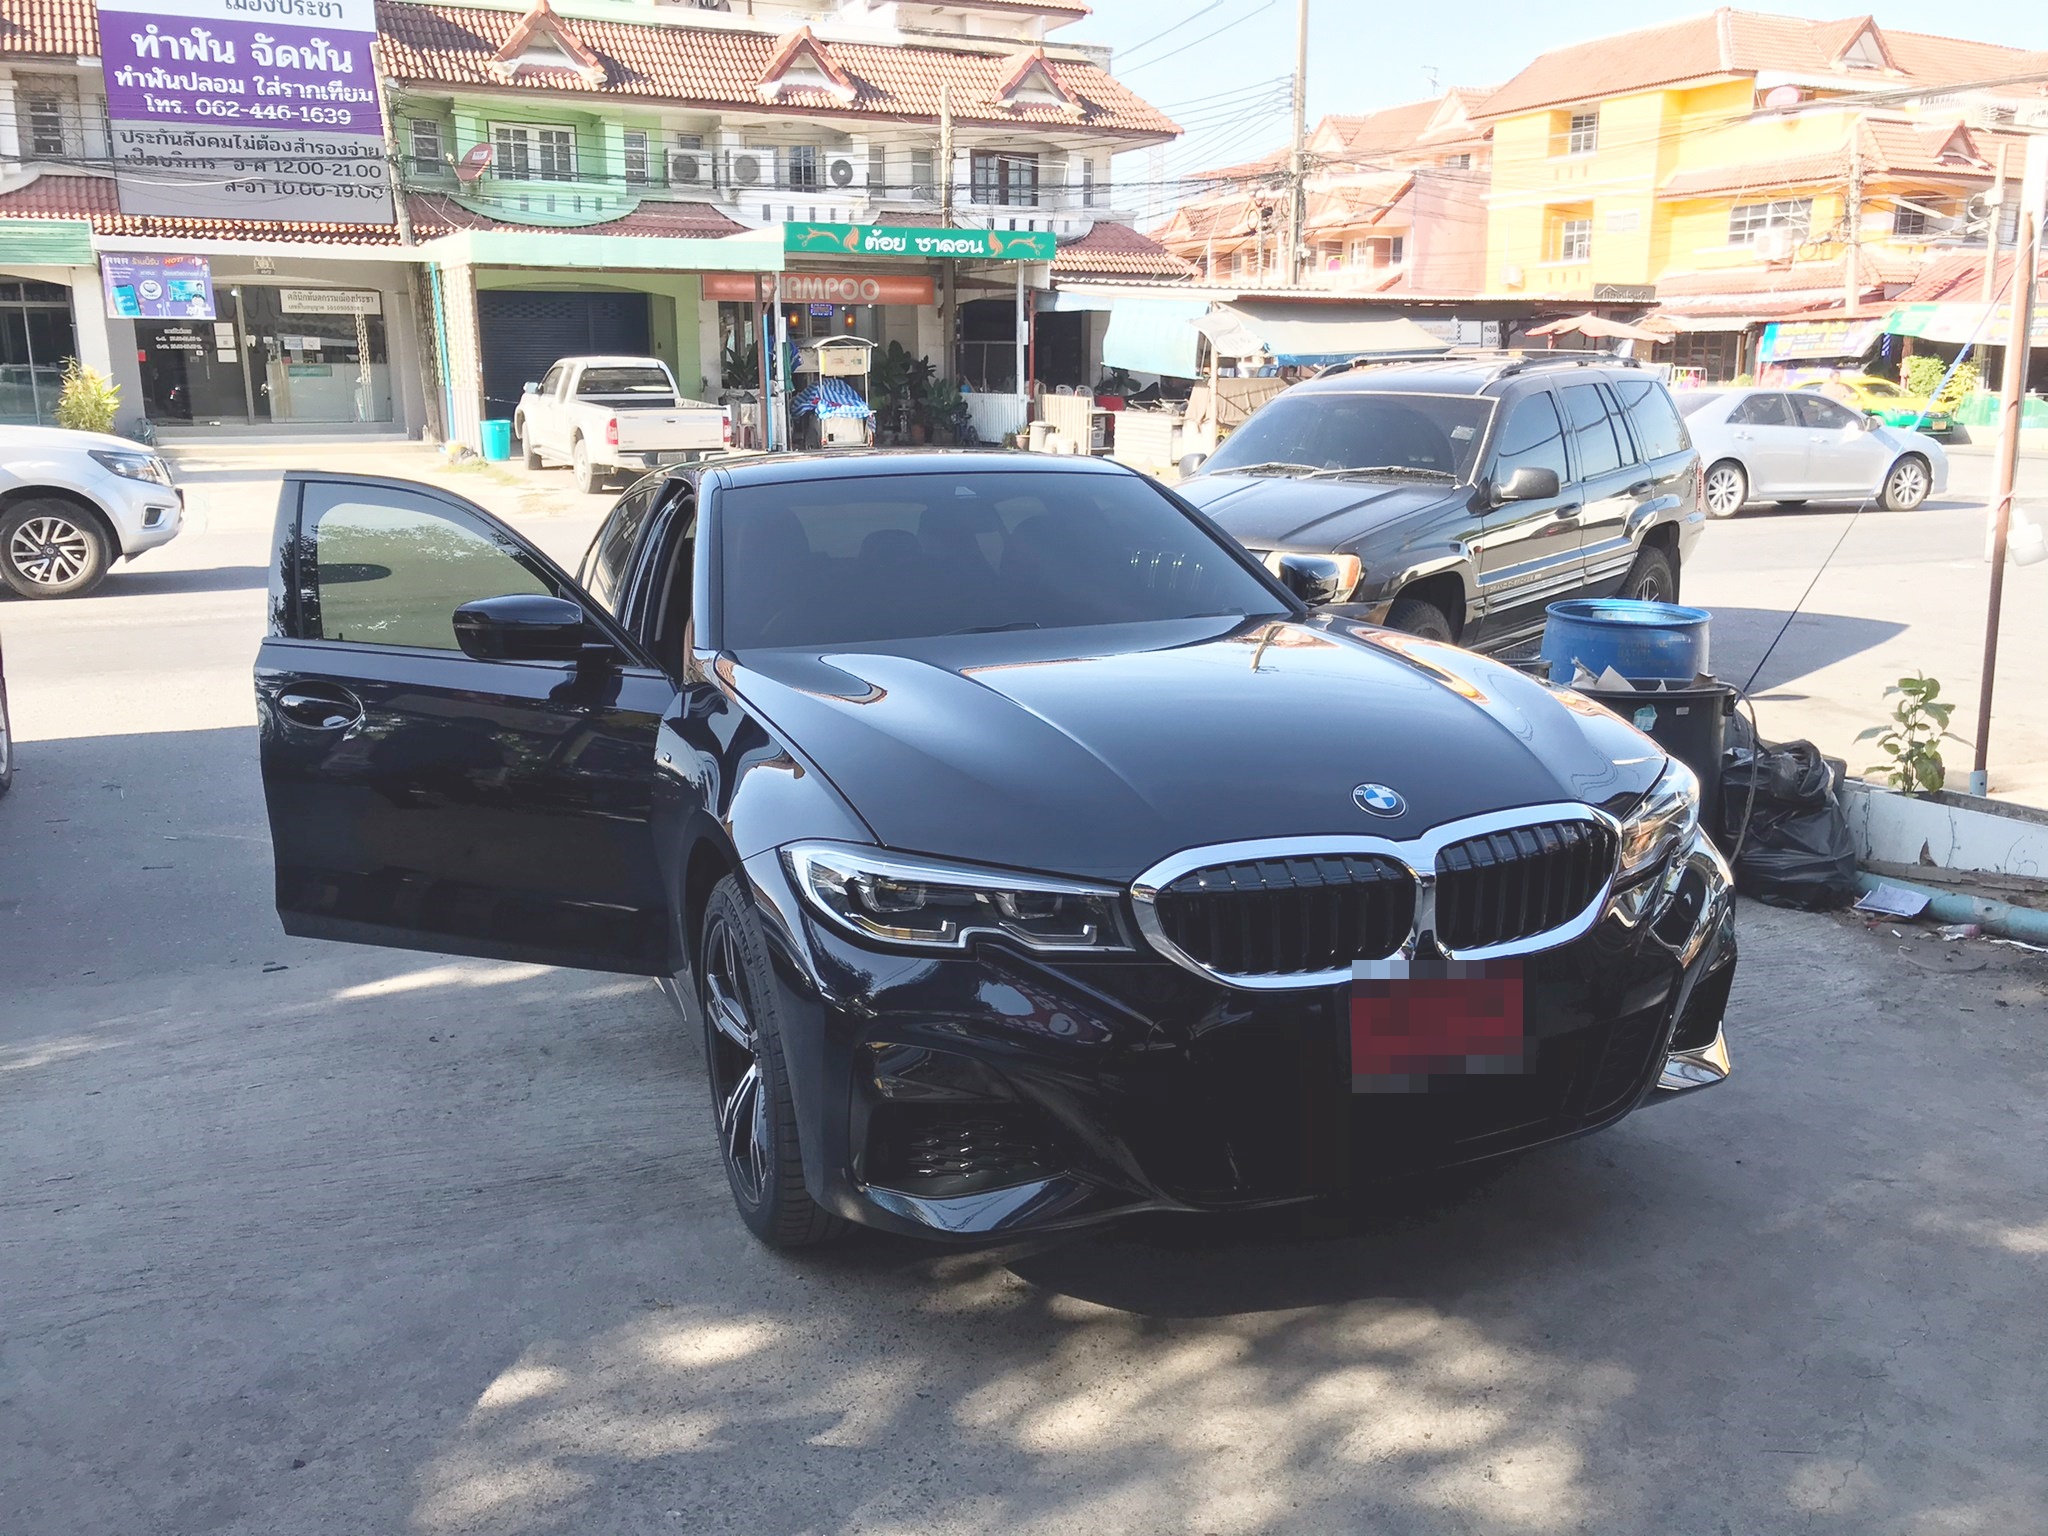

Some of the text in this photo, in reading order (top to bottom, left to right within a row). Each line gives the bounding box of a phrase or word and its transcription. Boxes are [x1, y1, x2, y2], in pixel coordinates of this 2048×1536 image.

[130, 23, 353, 74] ทำฟัน จัดฟัน
[114, 66, 374, 105] ทำฟันปลอม ใส่รากเทียม
[143, 93, 352, 126] โทร. 062-446-1639
[273, 160, 382, 179] 12.00-21.00
[863, 228, 984, 255] ต้อย ซาลอน
